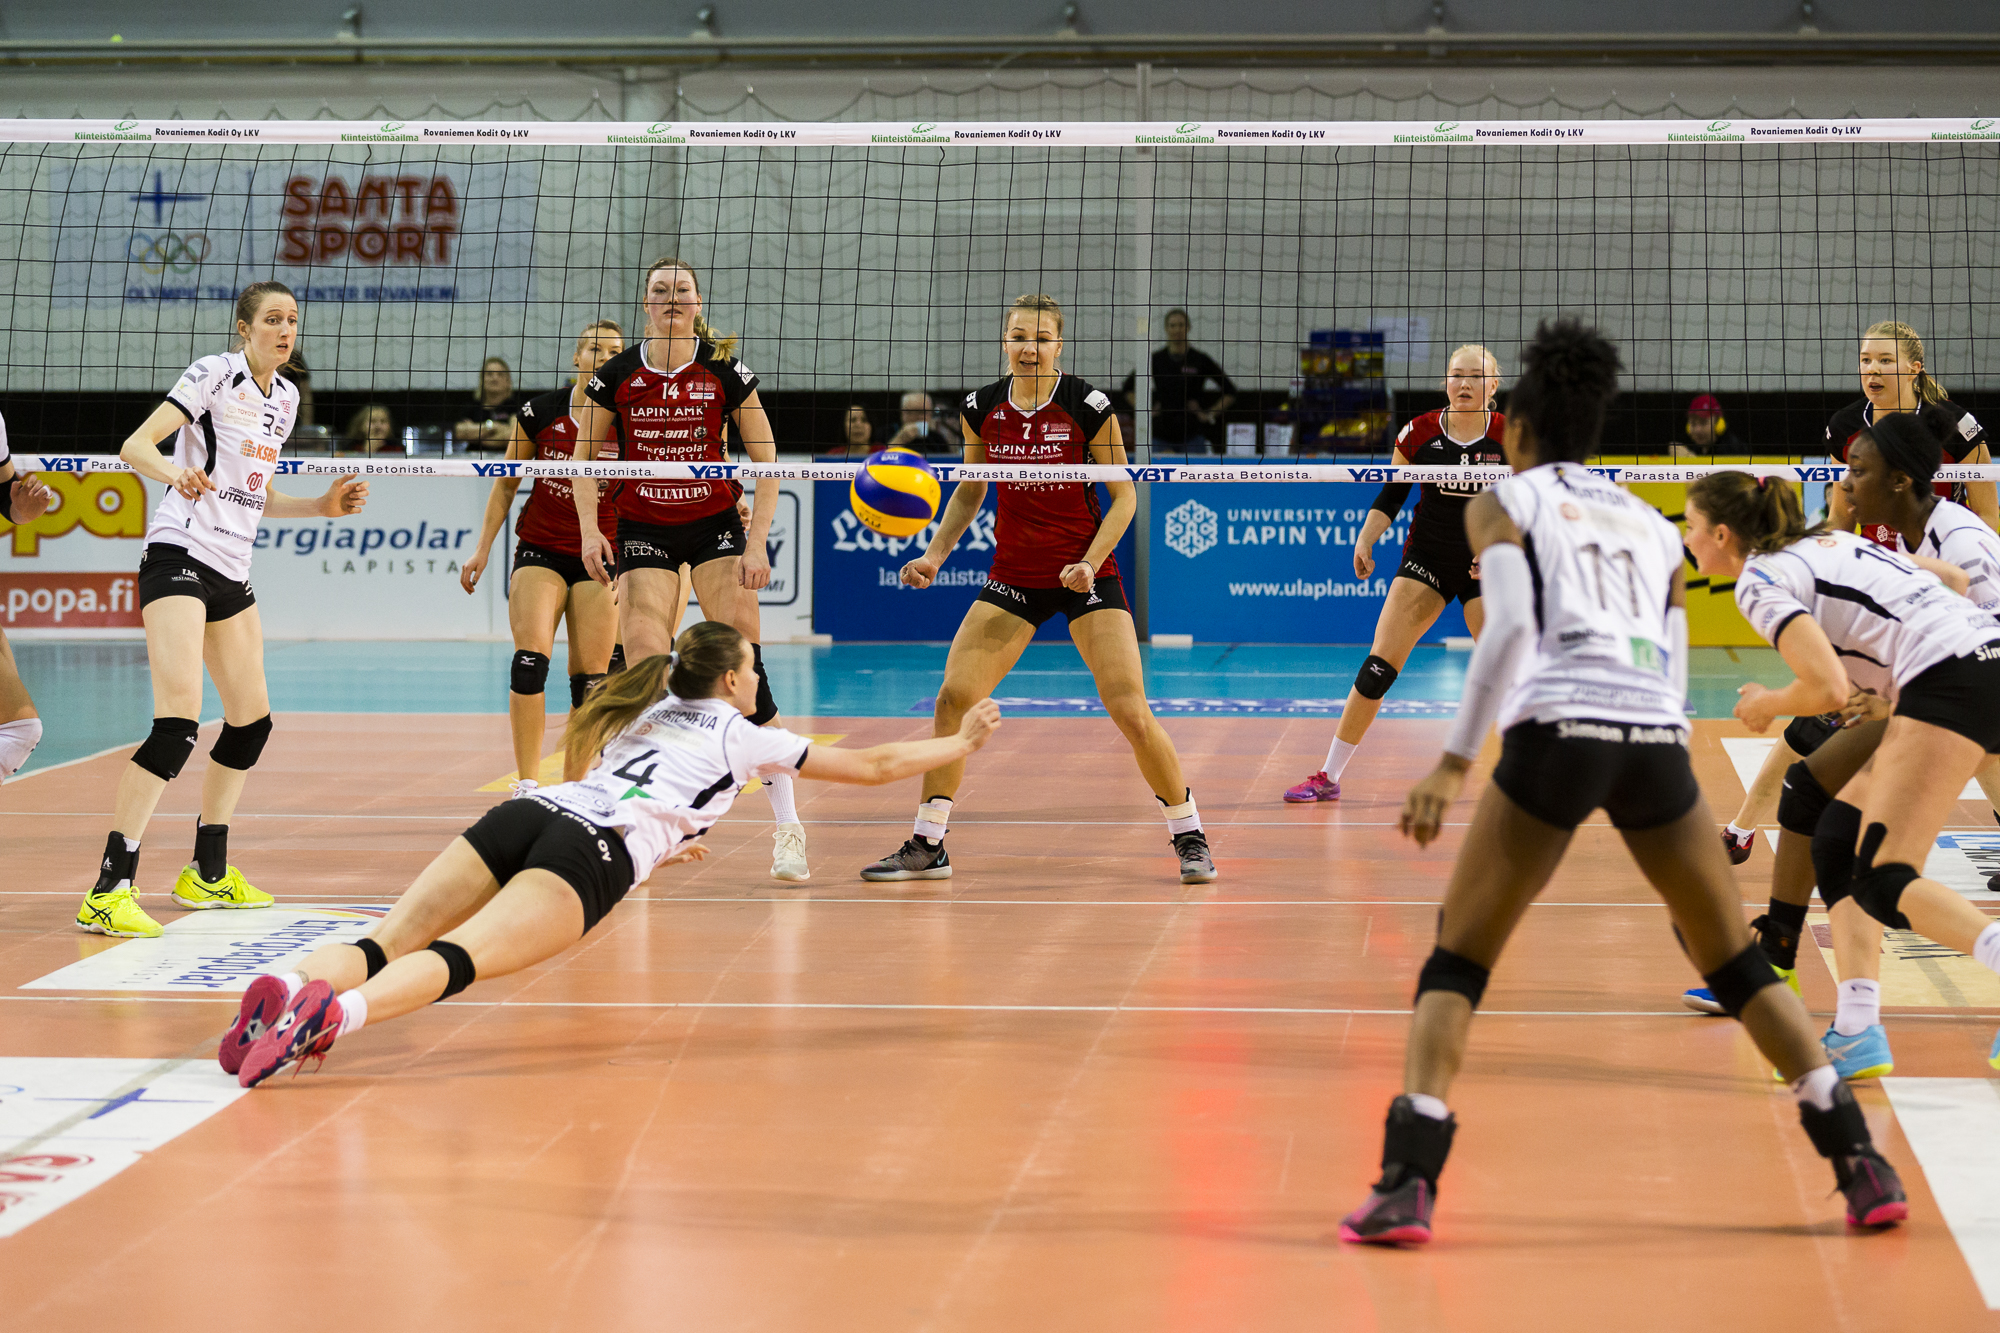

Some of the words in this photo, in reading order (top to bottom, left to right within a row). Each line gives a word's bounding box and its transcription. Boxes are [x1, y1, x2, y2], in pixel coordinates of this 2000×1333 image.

[74, 132, 152, 141] Kiinteistömaailma
[156, 128, 205, 136] Rovaniemen
[232, 130, 241, 138] Oy
[244, 129, 259, 137] LKV
[341, 133, 419, 142] Kiinteistömaailma
[424, 129, 474, 137] Rovaniemen
[477, 129, 498, 137] Kodit
[501, 130, 511, 139] Oy
[690, 130, 740, 138] Rovaniemen
[744, 130, 765, 138] Kodit
[768, 131, 777, 140] Oy
[955, 130, 1005, 138] Rovaniemen
[1009, 130, 1030, 138] Kodit
[1033, 130, 1043, 139] Oy
[1046, 130, 1061, 138] LKV
[1218, 130, 1269, 138] Rovaniemen
[1272, 130, 1293, 138] Kodit
[1296, 131, 1306, 140] Oy
[1393, 133, 1474, 142] Kiinteistömaailma
[1476, 129, 1527, 137] Rovaniemen
[1531, 129, 1552, 137] Kodit
[1555, 129, 1565, 138] Oy
[1568, 129, 1584, 137] LKV
[1667, 132, 1745, 141] Kiinteistömaailma
[1751, 127, 1803, 135] Rovaniemen
[1806, 126, 1828, 135] Kodit
[1832, 127, 1842, 136] Oy
[1846, 126, 1862, 135] LKV
[1931, 131, 2000, 140] Kiinteistömaailm
[607, 134, 686, 143] Kiinteistömaailma
[871, 134, 950, 143] Kiinteistömaailma
[1135, 134, 1215, 143] Kiinteistömaailma
[281, 174, 459, 220] SANTA
[277, 222, 458, 266] SPORT
[662, 382, 680, 400] 14
[237, 408, 258, 418] TOYOTA
[631, 407, 669, 417] LAPIN
[674, 405, 704, 416] AMK
[262, 413, 275, 437] 3
[1022, 423, 1032, 440] 7
[255, 444, 278, 465] KSBR
[637, 442, 708, 456] Energiapolar
[989, 442, 1026, 455] LAPIN
[1030, 442, 1062, 455] AMK
[39, 458, 89, 471] YBT
[91, 461, 134, 470] Paras
[1460, 453, 1470, 466] 8
[275, 461, 305, 474] BT
[307, 464, 360, 474] Parasta
[366, 464, 437, 474] Betonista.
[470, 463, 522, 477] YBT
[525, 466, 579, 476] Parasta
[584, 467, 655, 477] Betonista.
[687, 465, 739, 479] YBT
[741, 468, 796, 479] Parasta
[801, 470, 855, 479] Betonis
[1793, 467, 1847, 481] YBT
[1936, 470, 1985, 479] onista.
[959, 470, 1014, 479] Parasta
[1019, 470, 1091, 480] Betonista.
[1125, 468, 1177, 482] YBT
[1180, 471, 1235, 481] Parasta
[1240, 471, 1313, 481] Betonista.
[1347, 468, 1400, 482] YBT
[1403, 472, 1458, 481] Parasta
[1625, 472, 1680, 481] Parasta
[639, 485, 710, 500] KULTATUPA
[218, 489, 266, 511] UTRIAINE
[1226, 508, 1337, 522] UNIVERSITY
[1343, 508, 1366, 522] OF
[252, 520, 473, 556] ergiapolar
[1226, 525, 1307, 545] LAPIN
[321, 559, 461, 574] LAPISTA
[1228, 578, 1388, 600] www.ulapland.fi
[1974, 644, 2000, 661] Sim
[1556, 719, 1624, 743] Simon
[1628, 725, 1677, 745] Auto
[612, 749, 660, 788] 4
[597, 839, 612, 862] Oy
